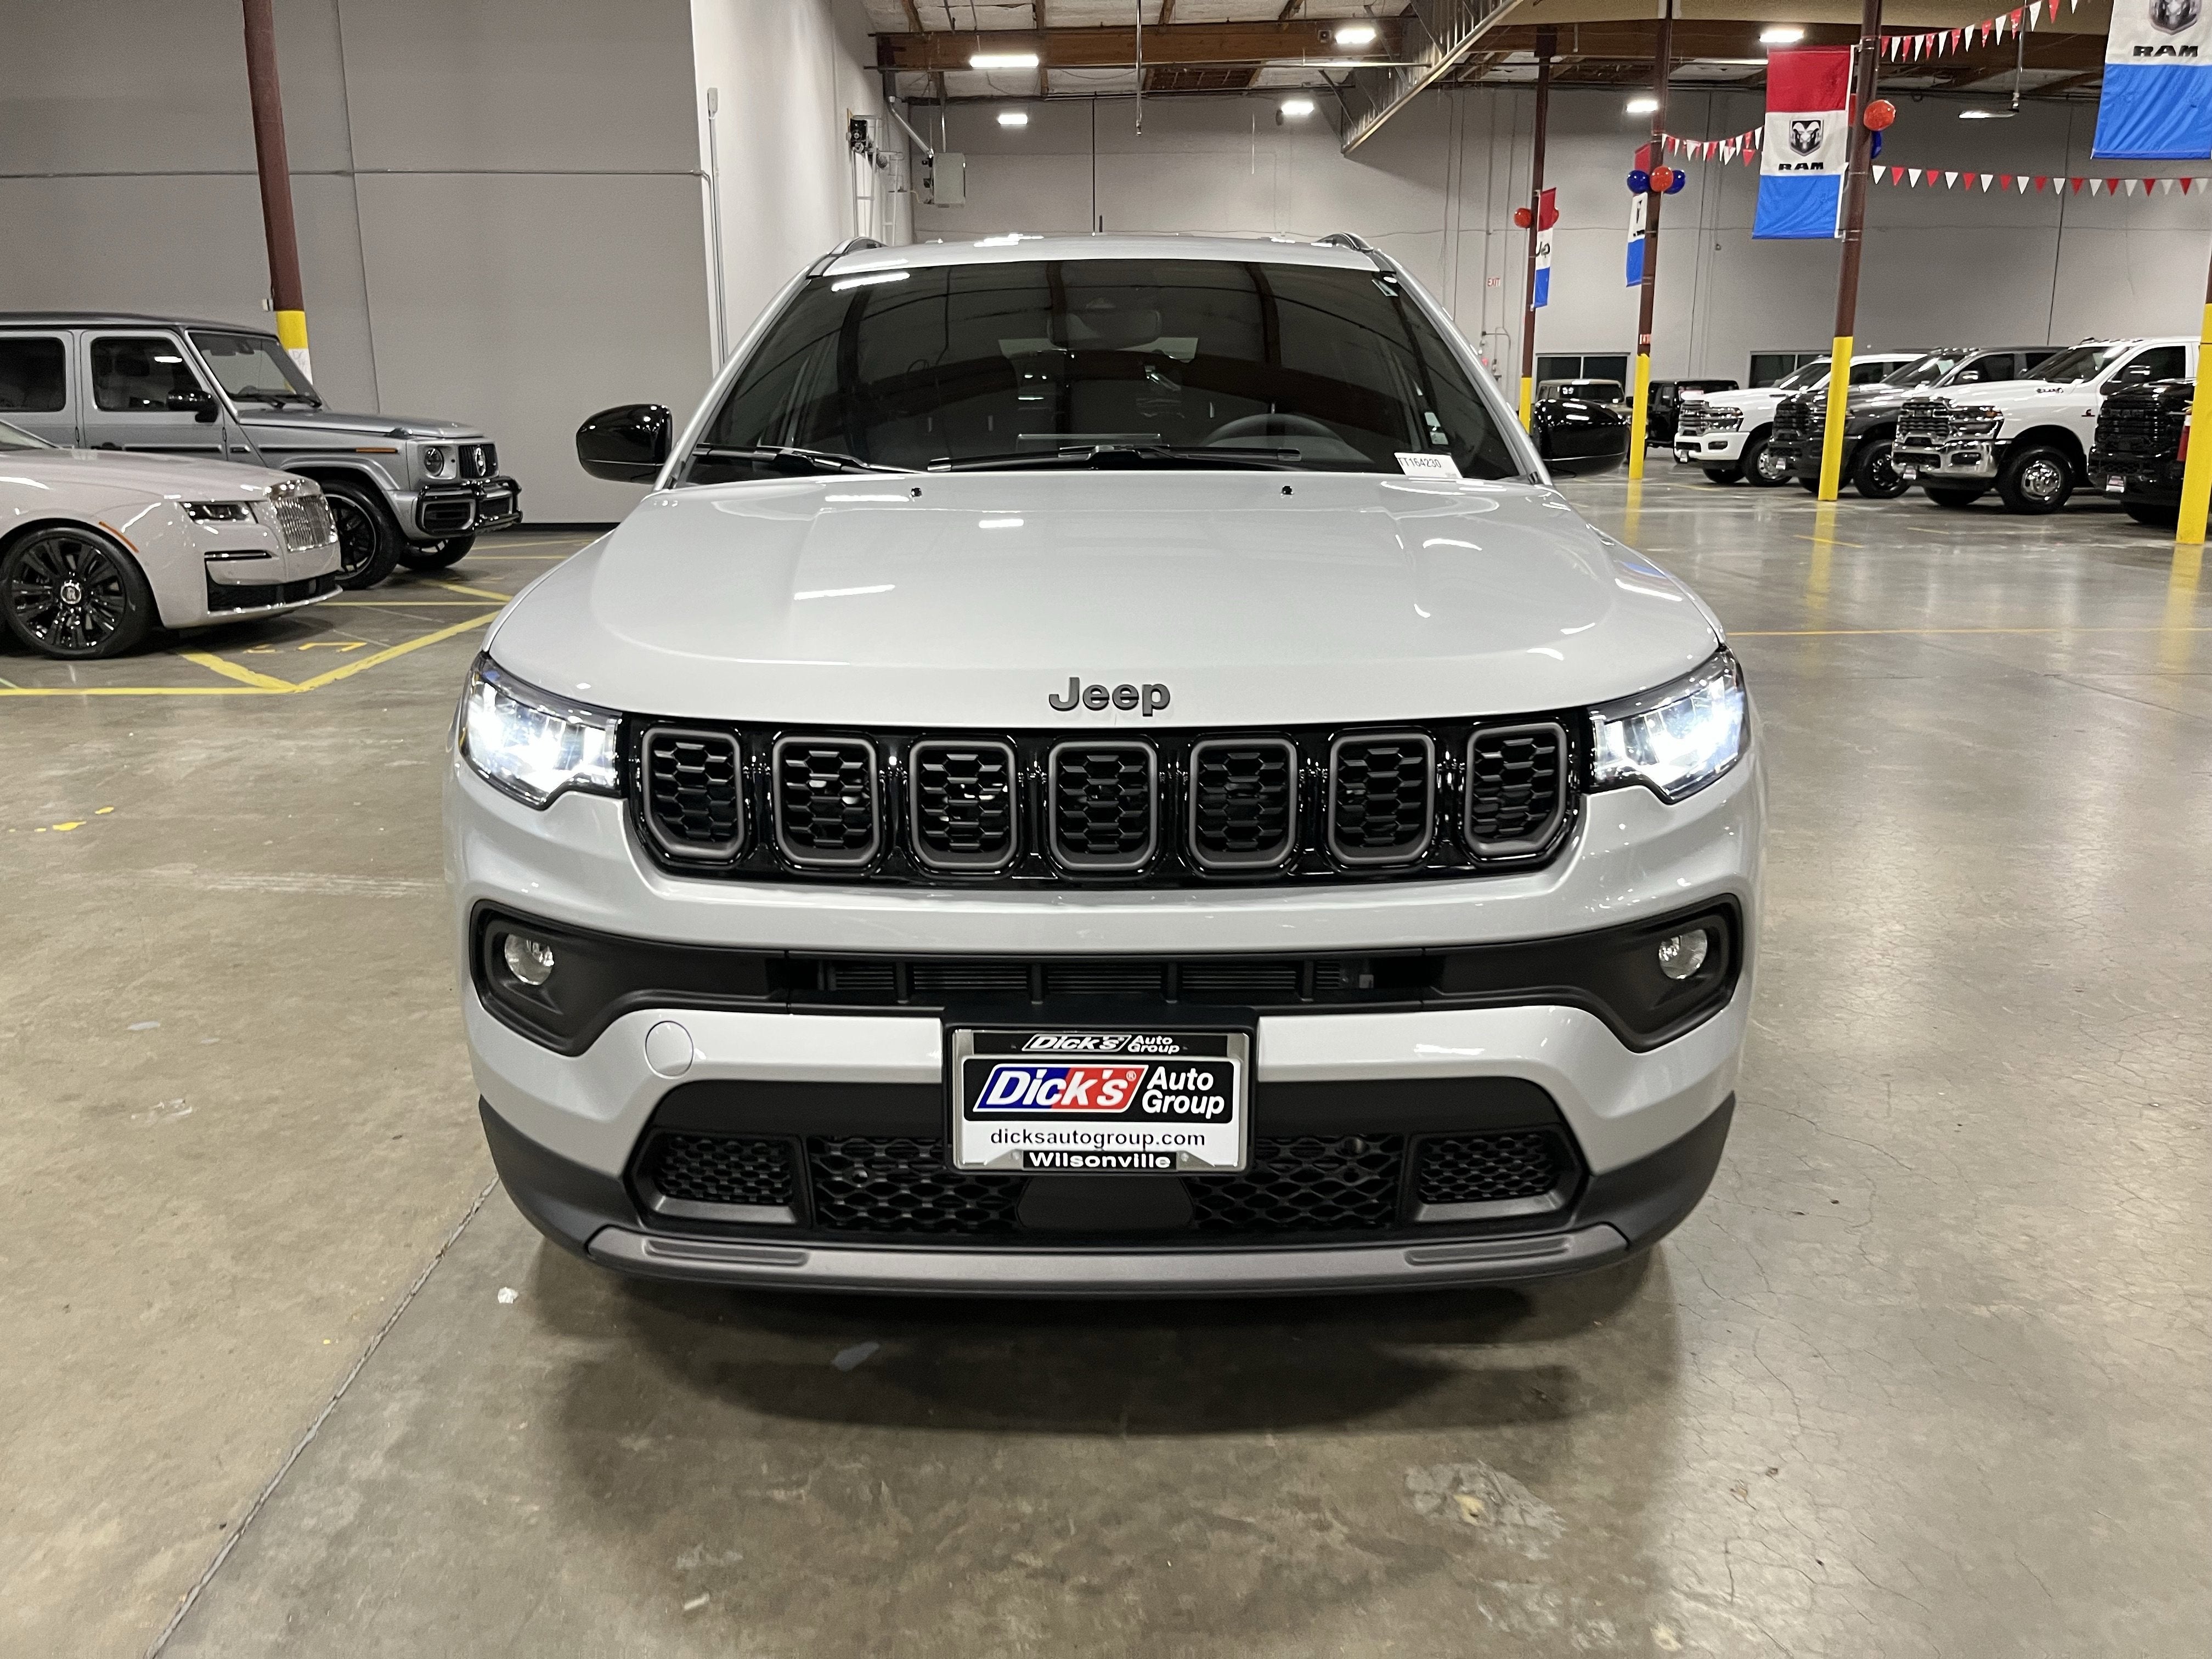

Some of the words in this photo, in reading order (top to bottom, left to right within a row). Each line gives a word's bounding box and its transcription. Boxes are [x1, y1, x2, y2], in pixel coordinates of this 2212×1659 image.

[2133, 45, 2199, 57] RAM
[1778, 162, 1824, 171] RAM
[1487, 278, 1500, 287] EXIT
[1048, 676, 1171, 717] Jeep
[1030, 1035, 1119, 1050] Dick's
[1132, 1035, 1173, 1045] Auto
[1127, 1043, 1180, 1054] Group
[985, 1068, 1129, 1107] Dick's
[1147, 1066, 1214, 1091] Auto
[1142, 1090, 1225, 1119] Group
[990, 1129, 1205, 1152] dicksautogroup.com
[1029, 1152, 1171, 1168] Wilsonville
